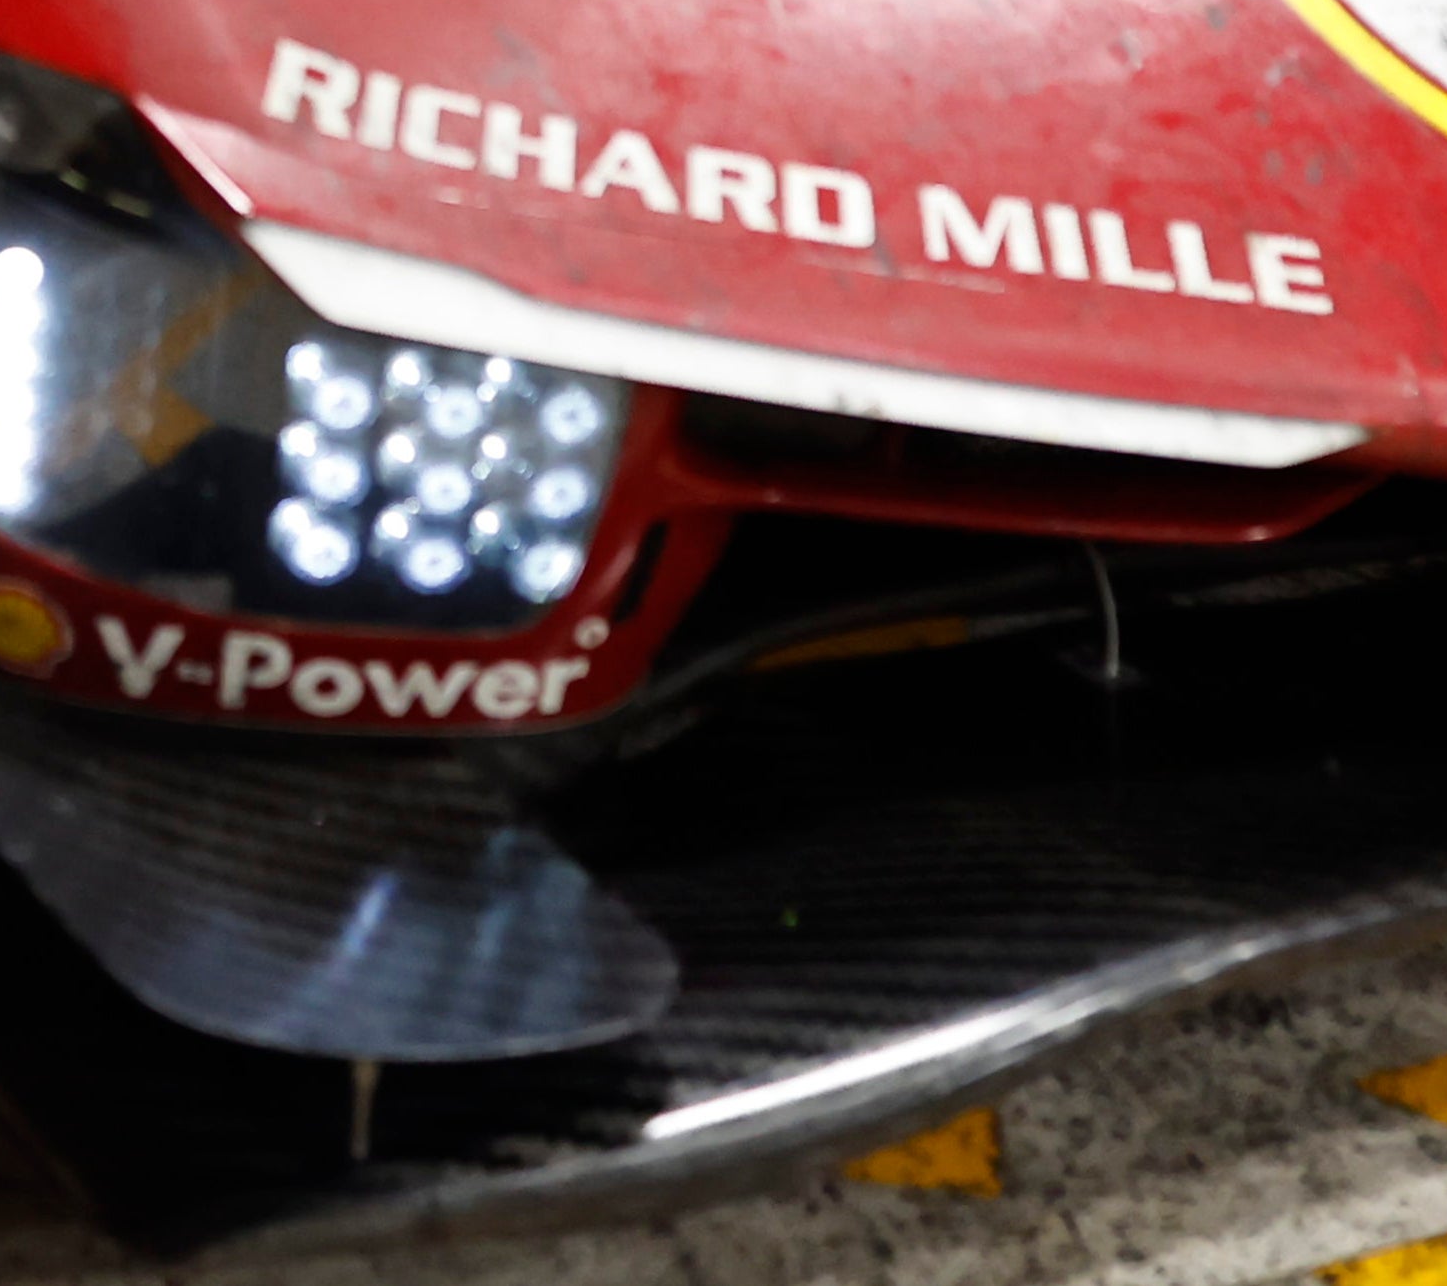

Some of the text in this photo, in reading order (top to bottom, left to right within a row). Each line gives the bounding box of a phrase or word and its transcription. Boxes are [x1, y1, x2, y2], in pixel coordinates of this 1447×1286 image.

[260, 36, 1336, 317] RICHARD MILLE
[93, 614, 590, 721] V-Power
